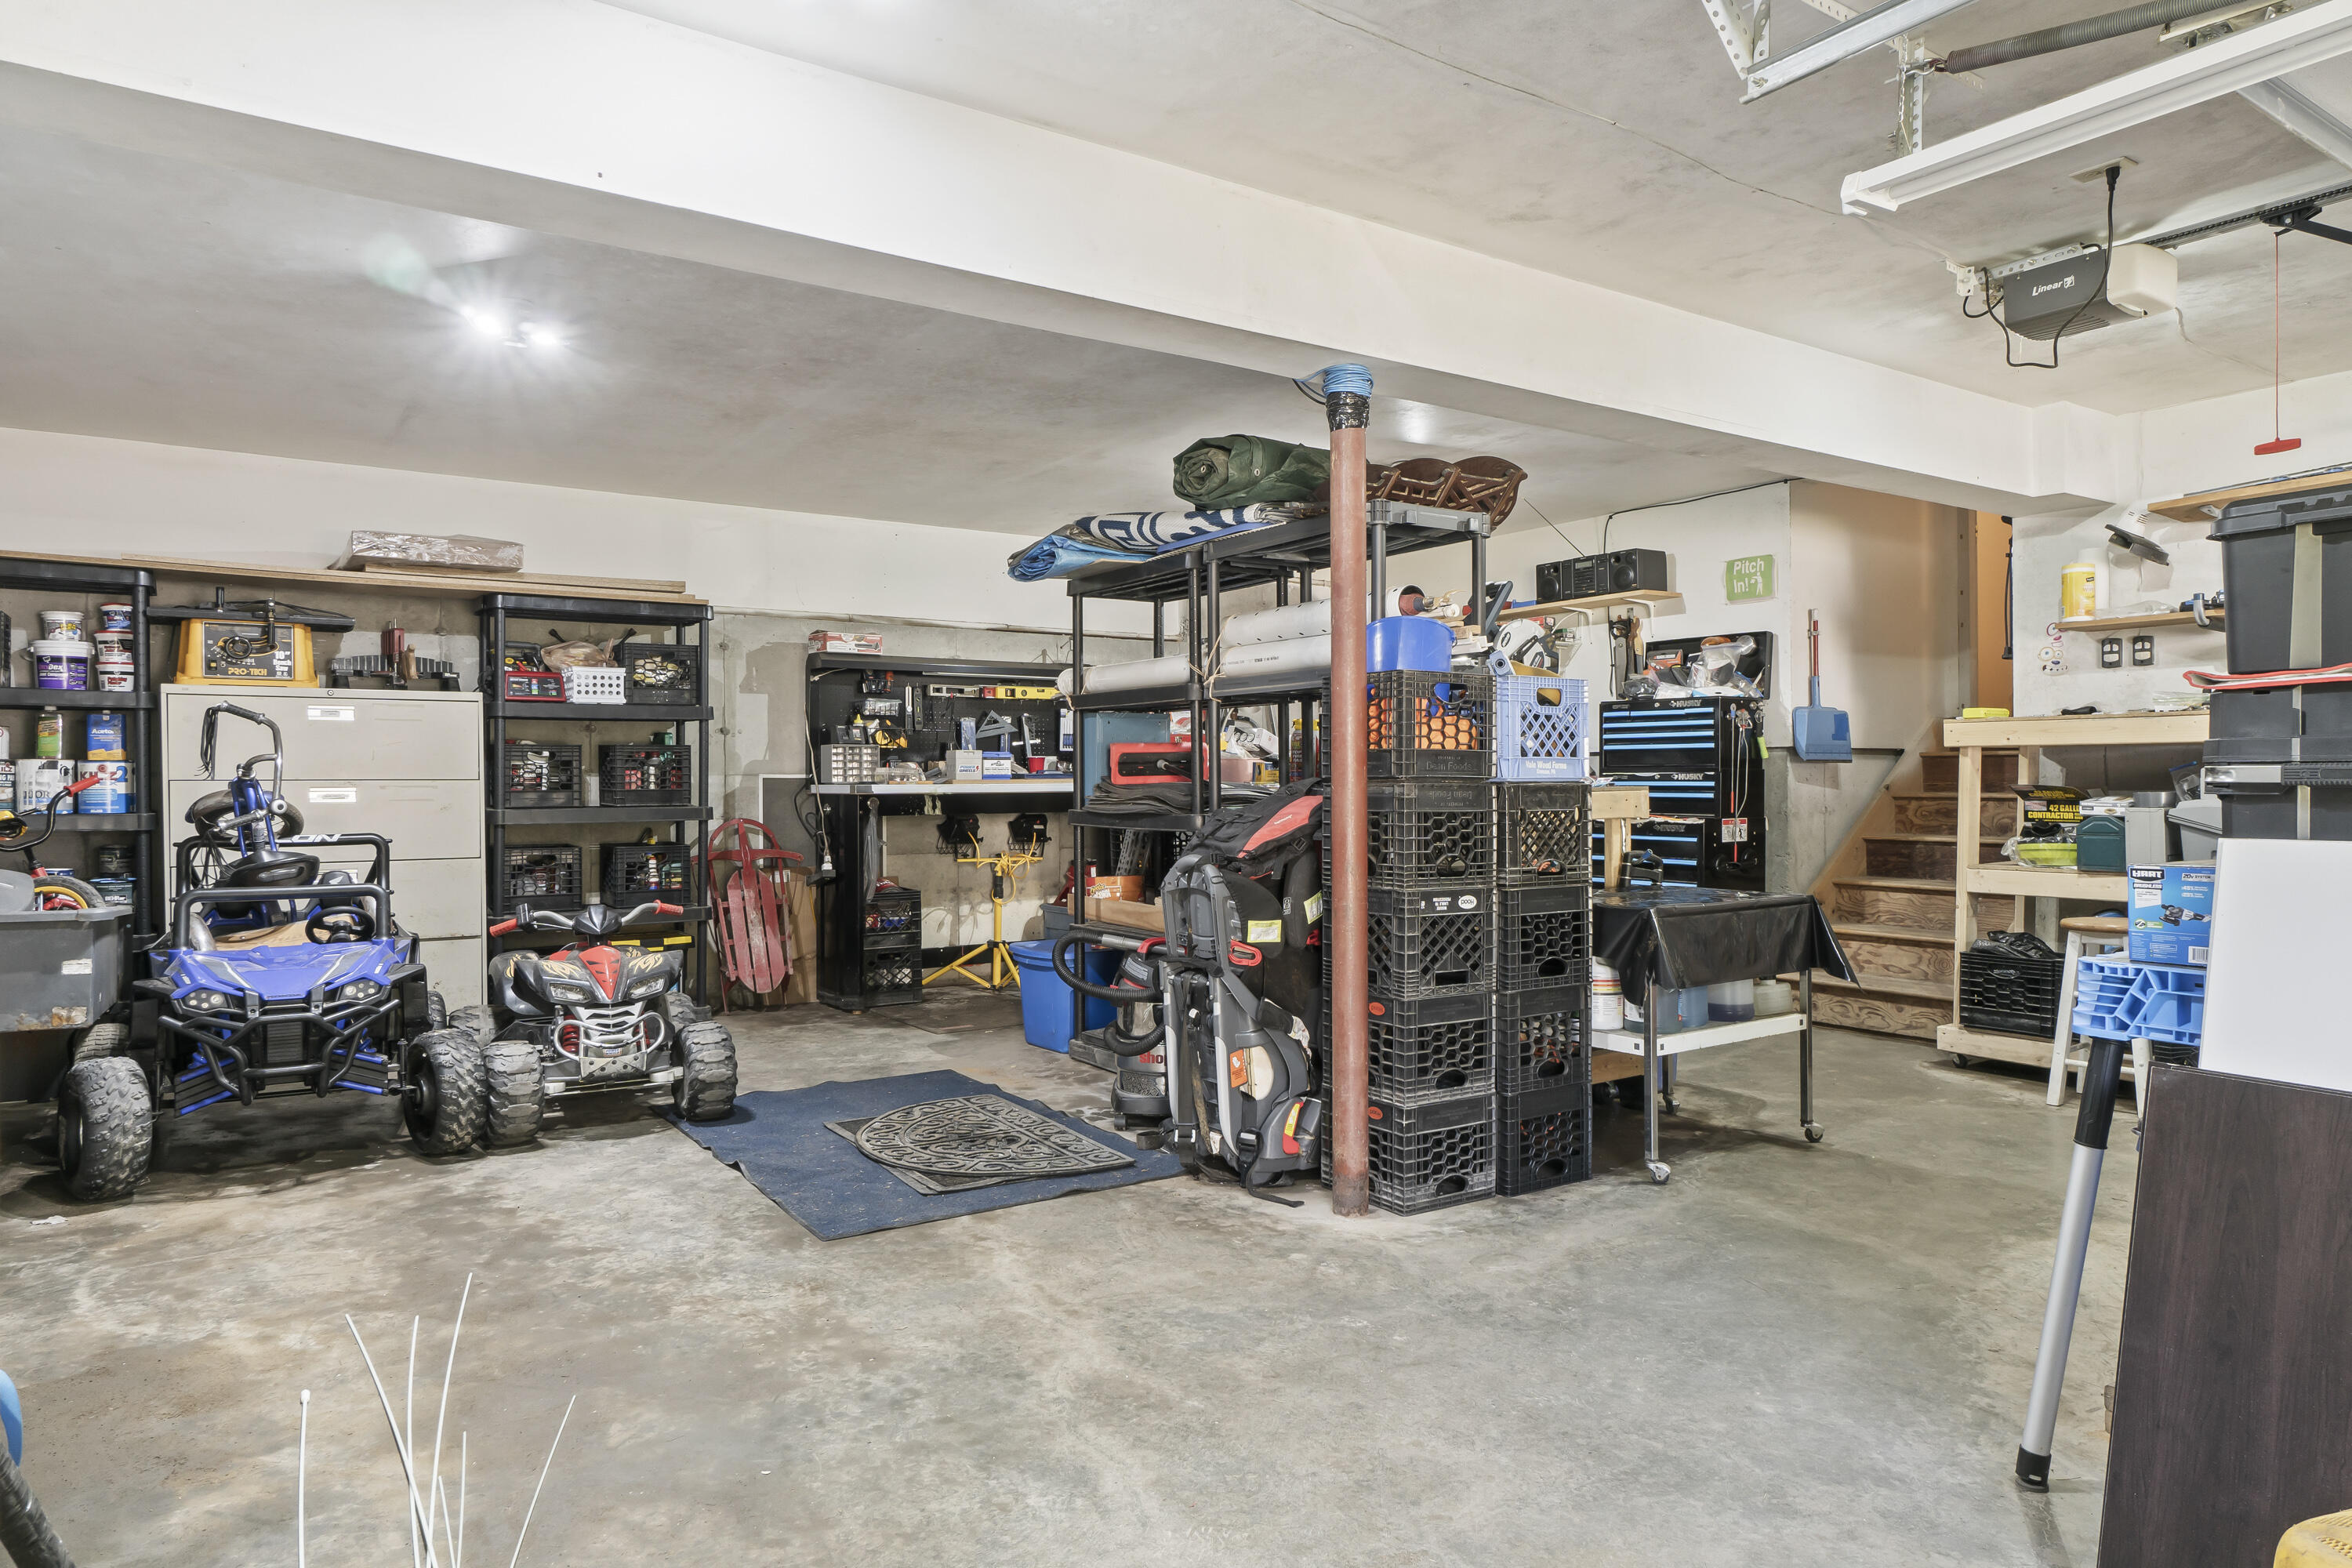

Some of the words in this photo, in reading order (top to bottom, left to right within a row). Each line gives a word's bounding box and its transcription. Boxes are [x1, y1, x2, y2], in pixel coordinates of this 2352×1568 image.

[2031, 281, 2063, 296] Linear
[1733, 557, 1765, 575] Pitch
[1733, 578, 1749, 593] In!
[227, 667, 267, 676] PRO-TECH
[1426, 761, 1446, 771] Dean
[1448, 760, 1473, 771] Foods
[117, 765, 129, 782] 2
[2027, 811, 2074, 820] CONTRACTOR
[2132, 869, 2163, 878] HART
